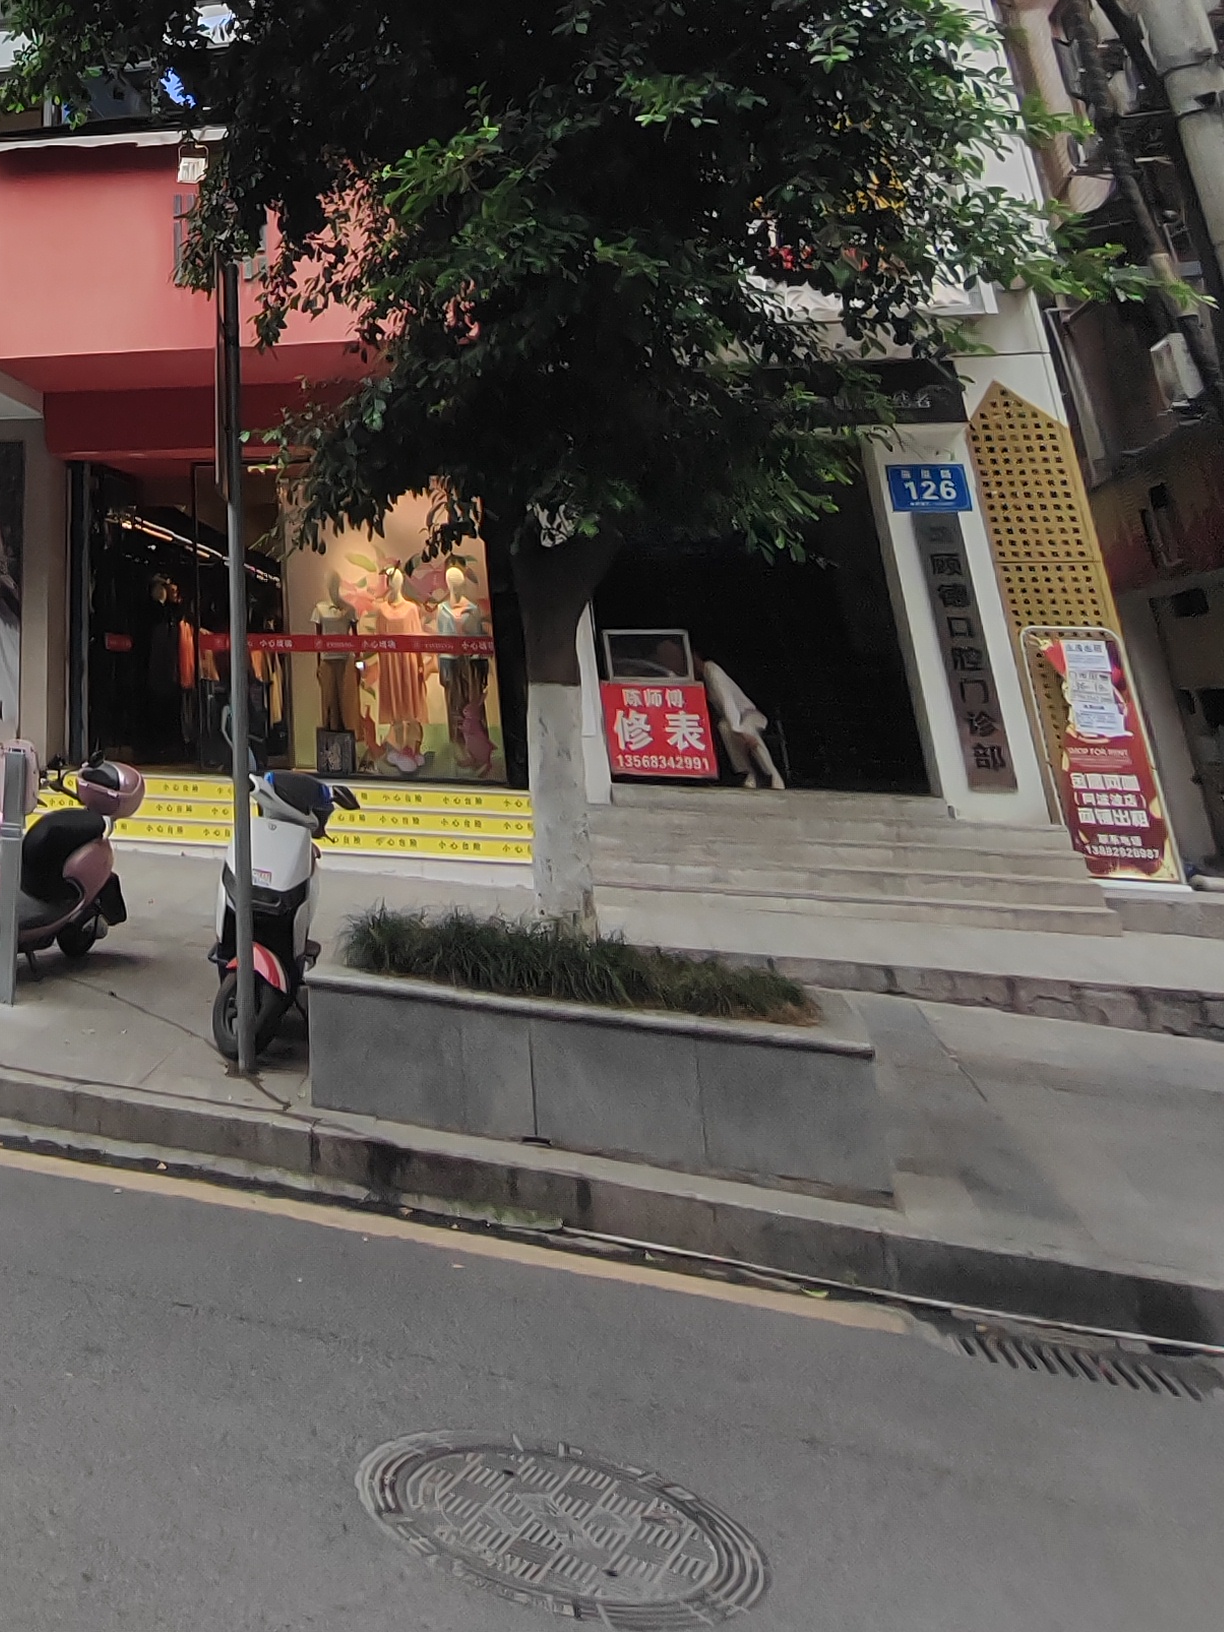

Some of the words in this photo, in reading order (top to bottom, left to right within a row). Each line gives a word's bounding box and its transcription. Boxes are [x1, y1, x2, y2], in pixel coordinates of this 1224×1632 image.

[903, 480, 958, 501] 126
[613, 708, 707, 751] 修表
[616, 754, 710, 771] 13568342991
